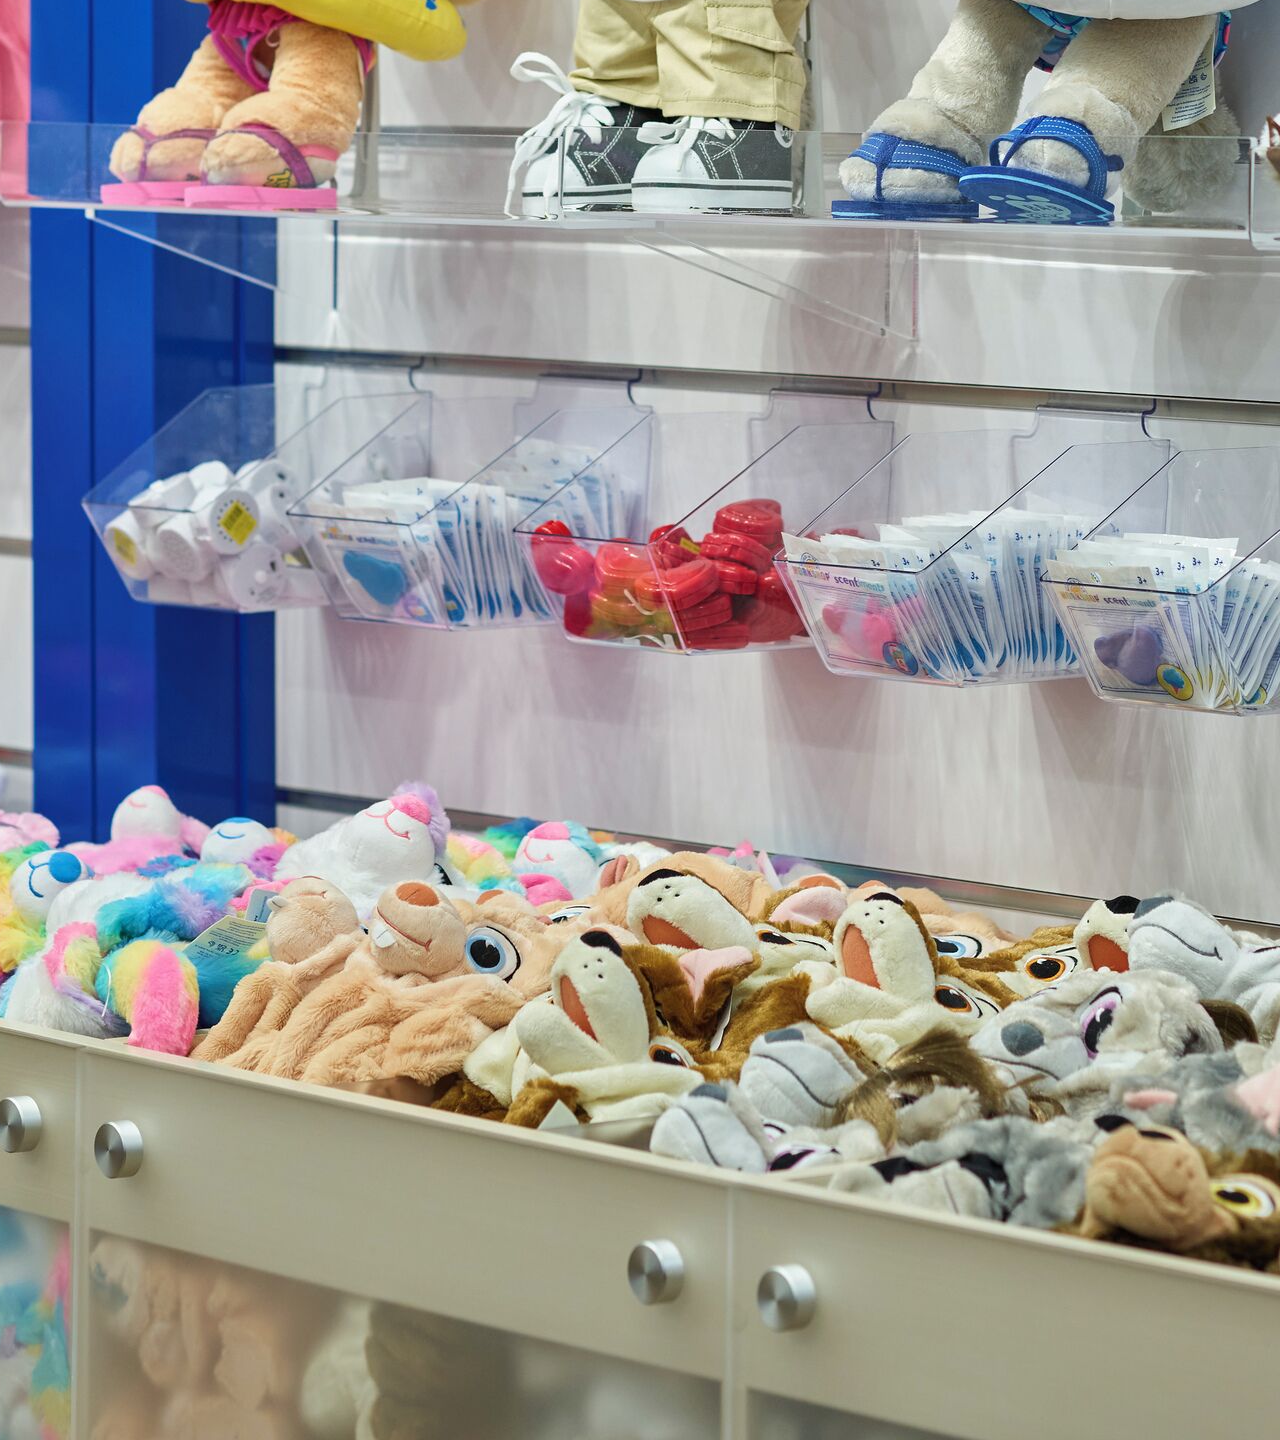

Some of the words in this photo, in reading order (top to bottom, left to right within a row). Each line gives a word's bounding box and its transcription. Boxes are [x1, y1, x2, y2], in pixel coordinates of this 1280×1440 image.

[1192, 557, 1202, 566] 3+
[1214, 557, 1224, 566] 3+
[1177, 562, 1186, 571] 3+
[1155, 567, 1165, 576] 3+
